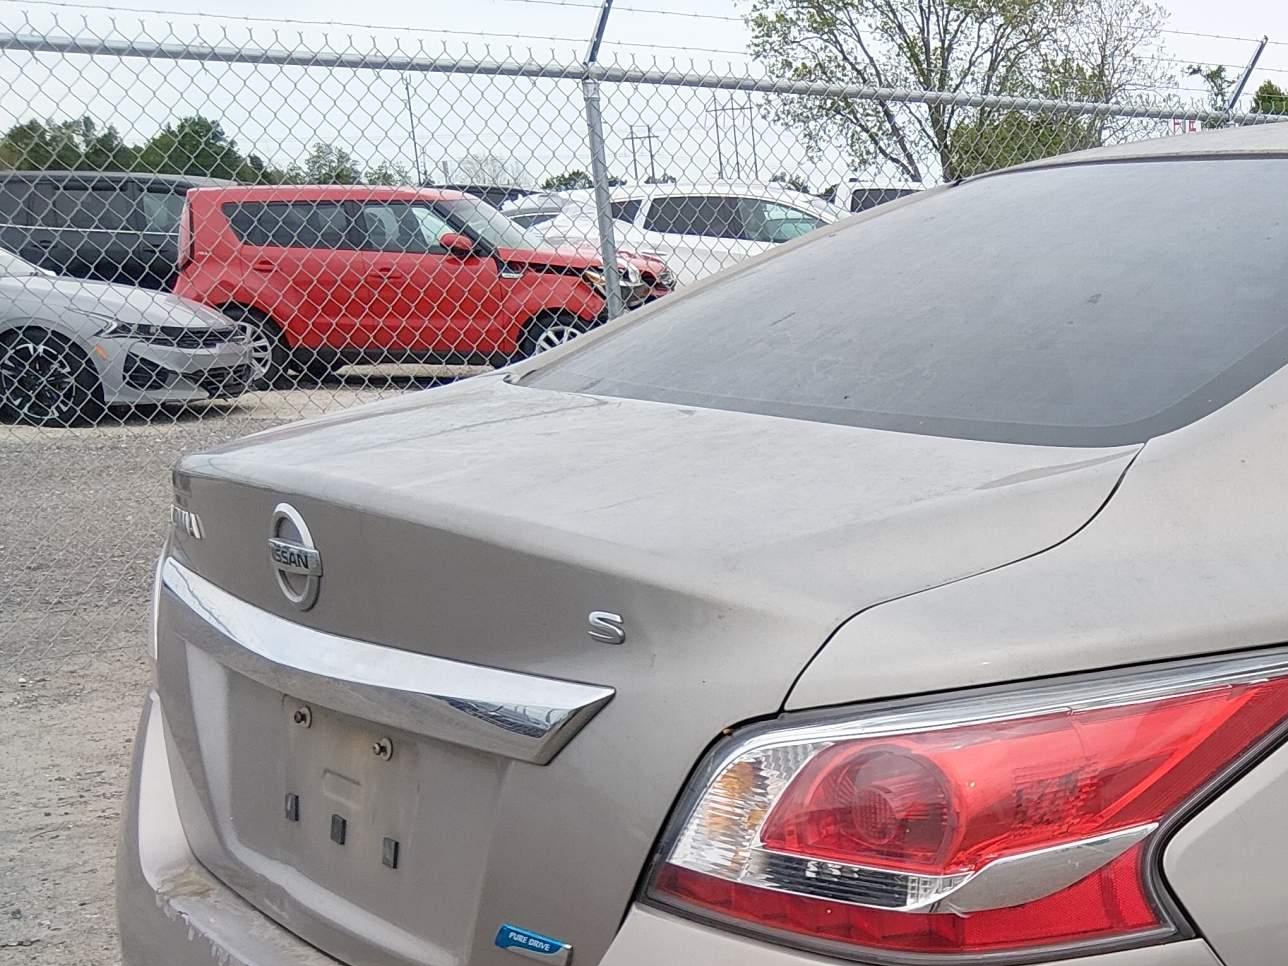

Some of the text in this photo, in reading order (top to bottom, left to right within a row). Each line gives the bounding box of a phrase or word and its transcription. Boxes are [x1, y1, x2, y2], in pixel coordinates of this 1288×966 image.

[587, 610, 625, 645] S
[508, 931, 551, 952] PURE DRIVE
